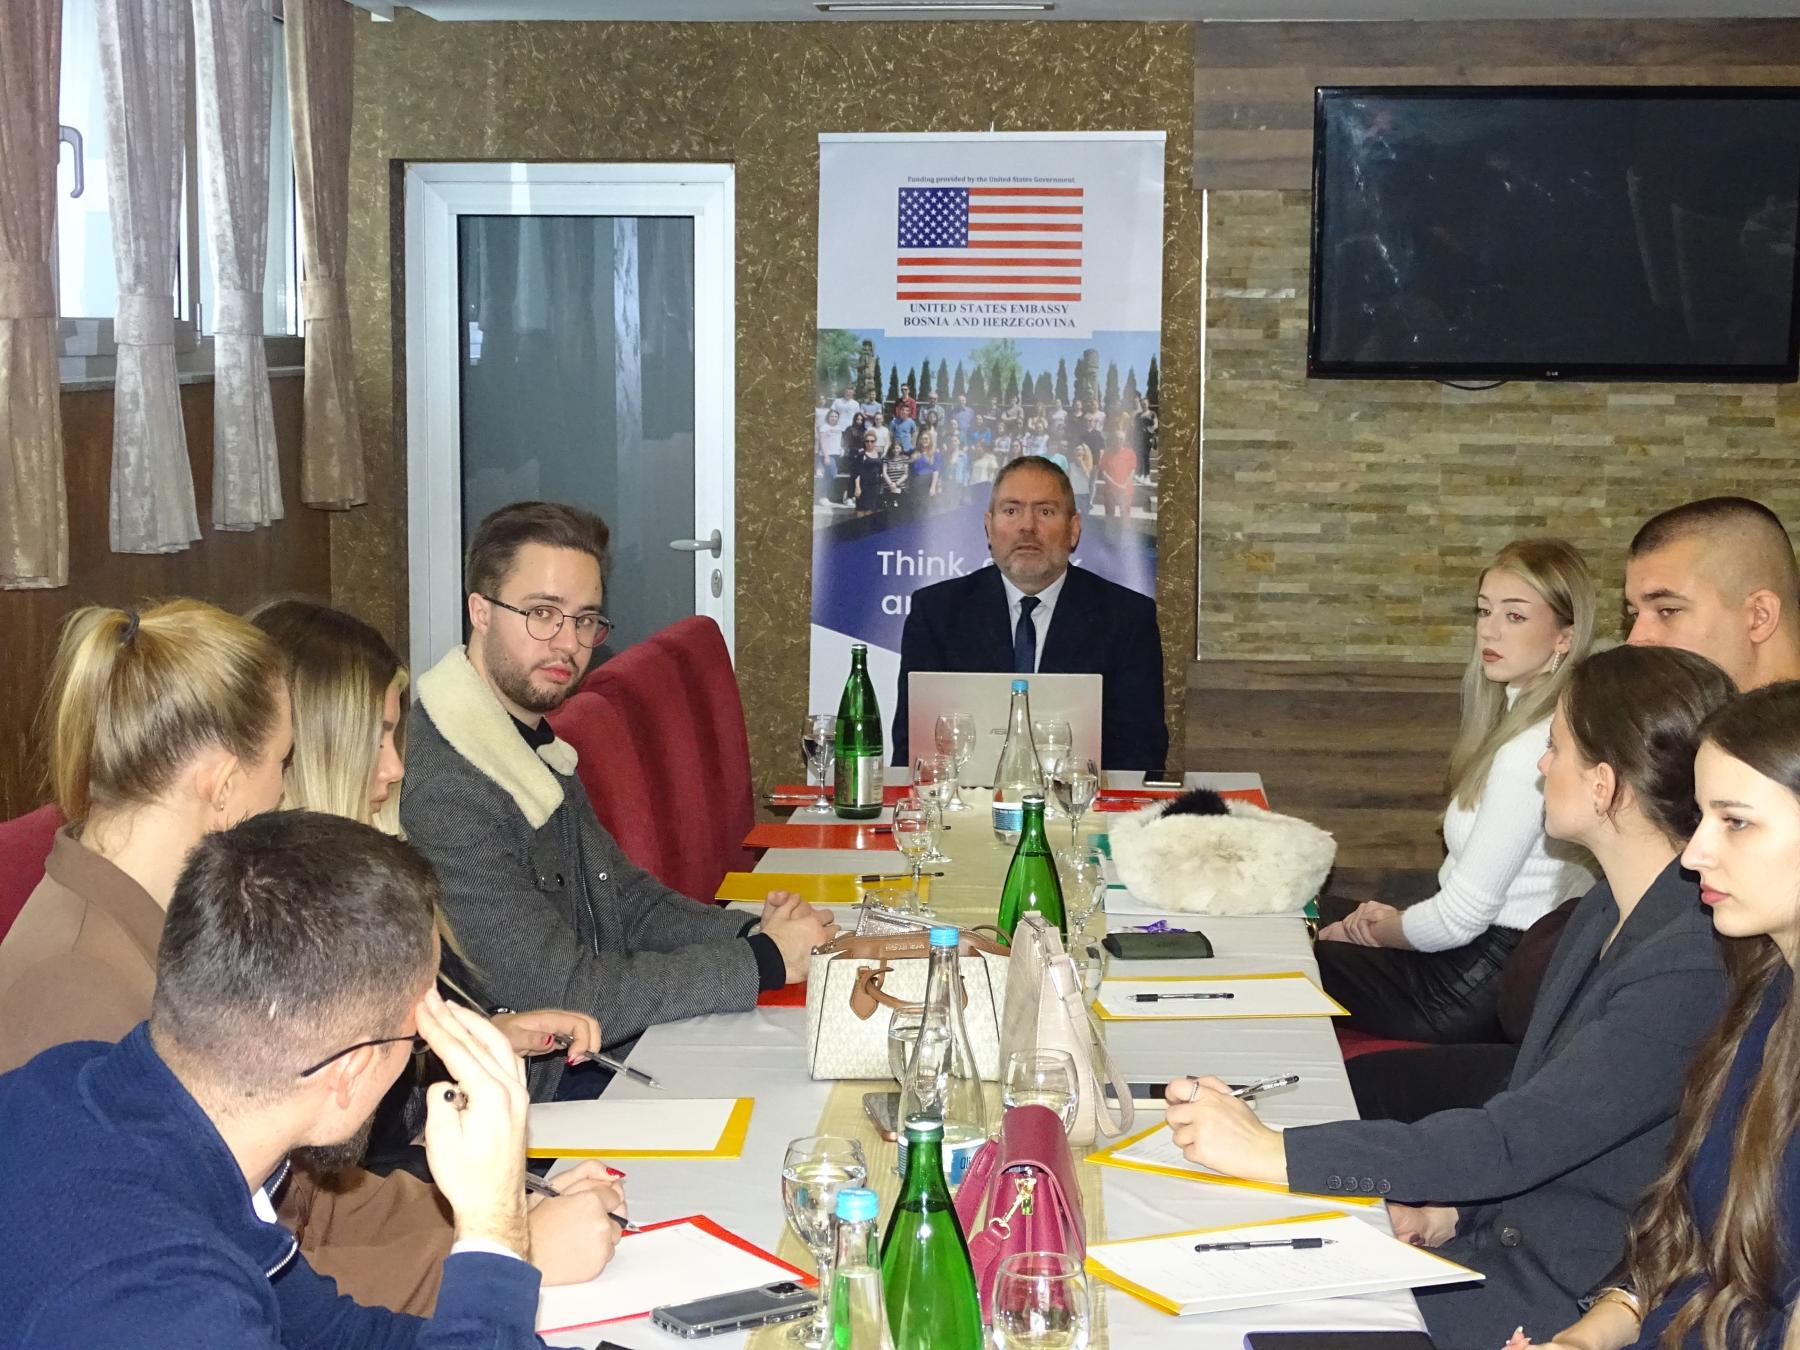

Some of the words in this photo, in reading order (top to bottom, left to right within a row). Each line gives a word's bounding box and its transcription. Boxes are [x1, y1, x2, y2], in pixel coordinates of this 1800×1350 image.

[910, 303, 957, 313] UNITED
[960, 303, 1007, 313] STATES
[1010, 304, 1070, 314] EMBASSY
[903, 316, 949, 327] BOSNIA
[953, 317, 979, 327] AND
[983, 317, 1076, 328] HERZEGOVINA
